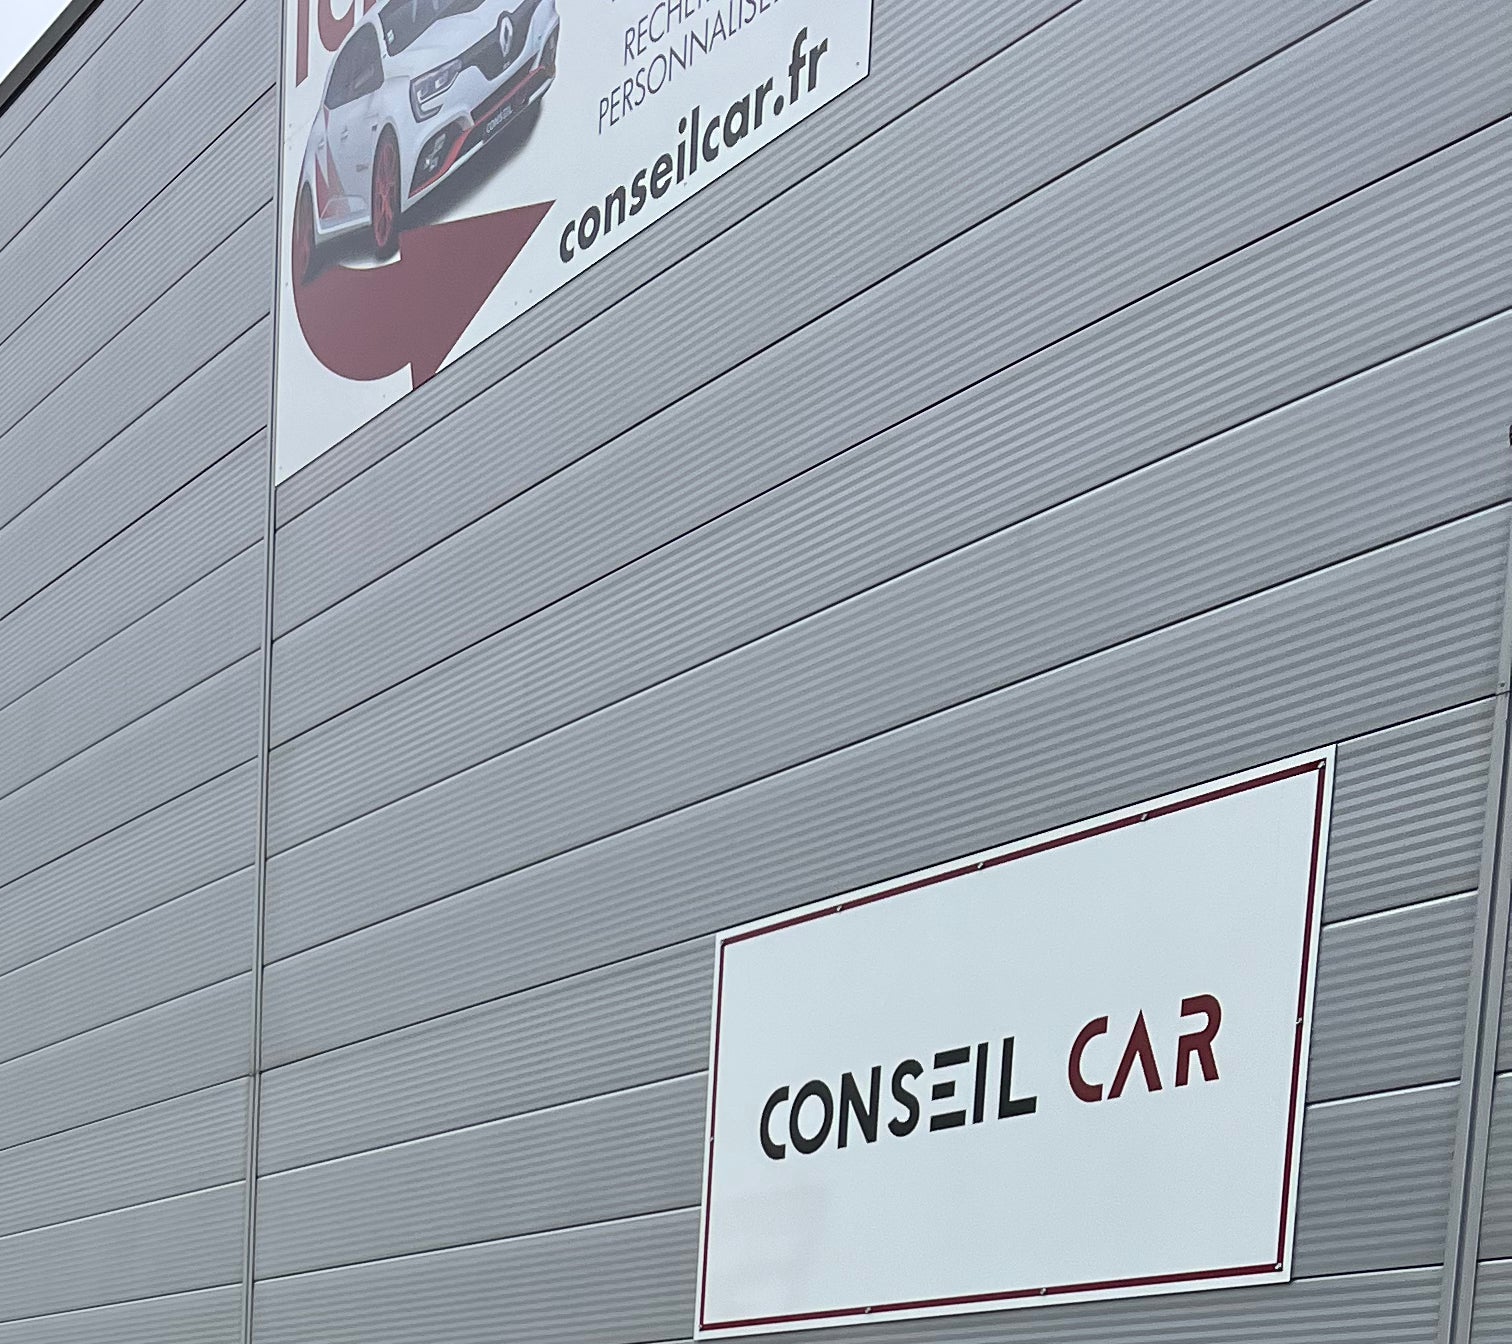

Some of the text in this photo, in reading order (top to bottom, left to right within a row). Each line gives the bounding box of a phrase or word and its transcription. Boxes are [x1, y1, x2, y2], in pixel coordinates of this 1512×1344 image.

[559, 26, 829, 263] conseilcar.fr
[760, 994, 1222, 1160] CONSEIL CAR
